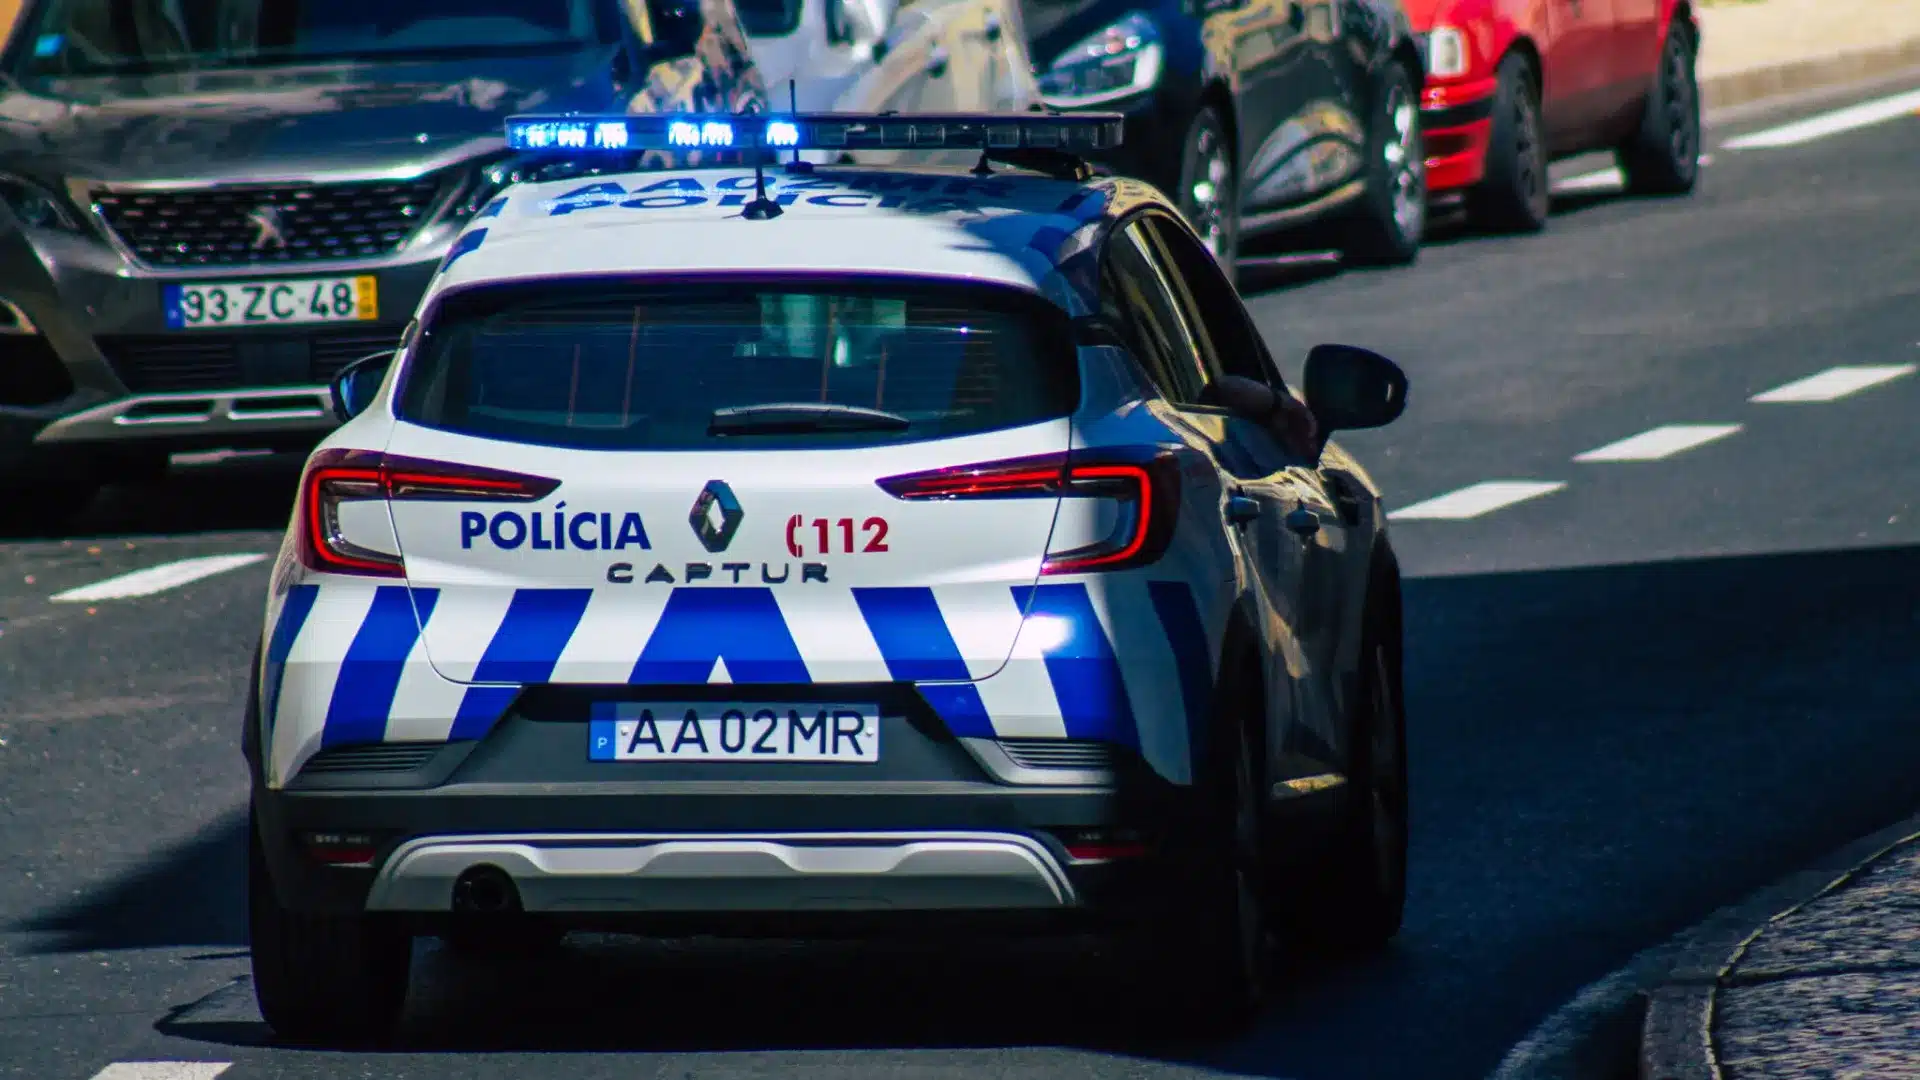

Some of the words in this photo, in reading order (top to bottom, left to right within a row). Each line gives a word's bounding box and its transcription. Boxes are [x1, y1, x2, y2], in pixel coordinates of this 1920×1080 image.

[460, 501, 652, 550] POLÍCIA
[812, 517, 889, 554] 112
[606, 562, 829, 584] CAPTUR
[597, 736, 608, 748] P
